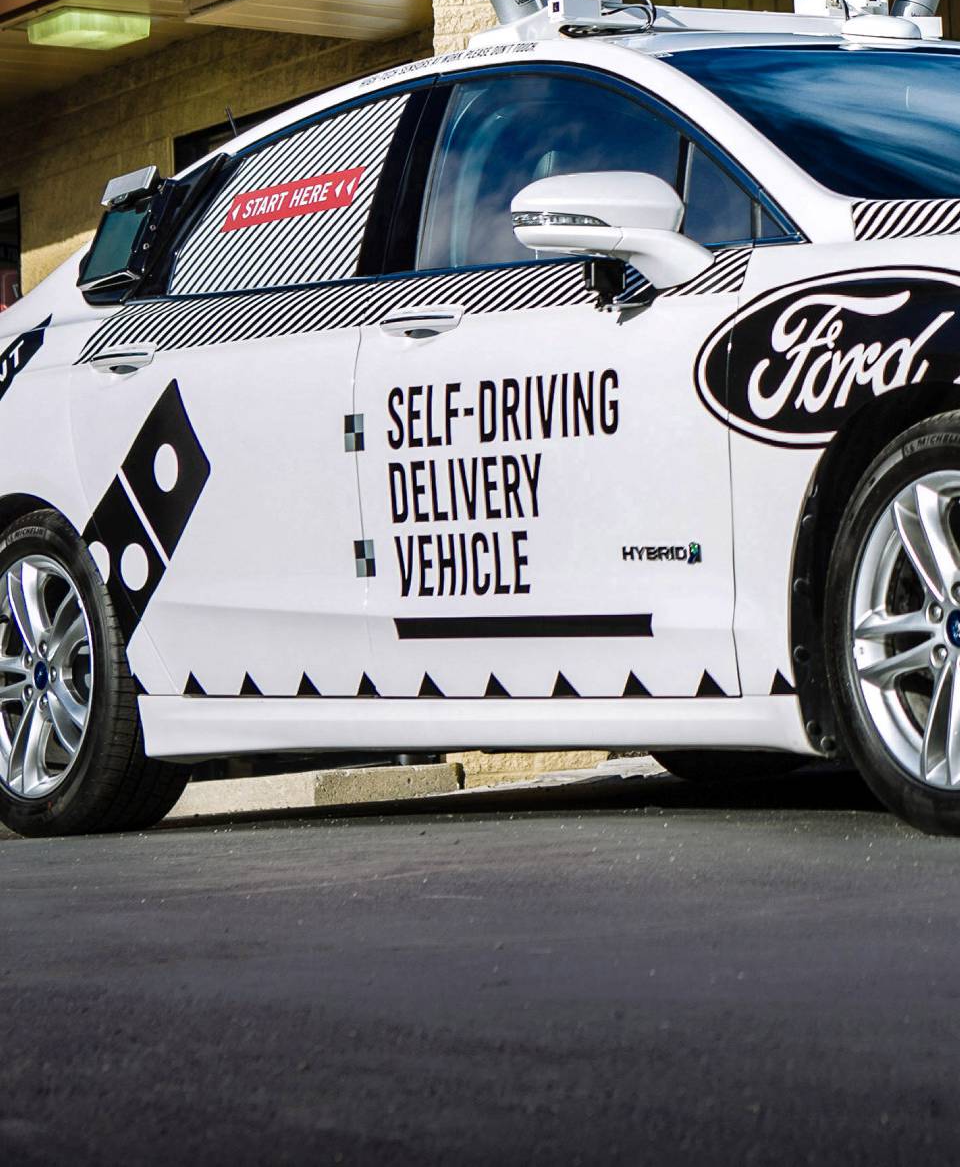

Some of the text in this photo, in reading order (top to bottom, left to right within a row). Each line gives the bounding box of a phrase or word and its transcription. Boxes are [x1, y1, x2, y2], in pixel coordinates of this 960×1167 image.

[242, 181, 333, 219] START HERE
[747, 289, 956, 420] Ford
[386, 367, 620, 450] SELF-DRIVING
[387, 452, 543, 524] DELIVERY
[393, 530, 531, 597] VEHICLE
[621, 546, 688, 562] HYBRID
